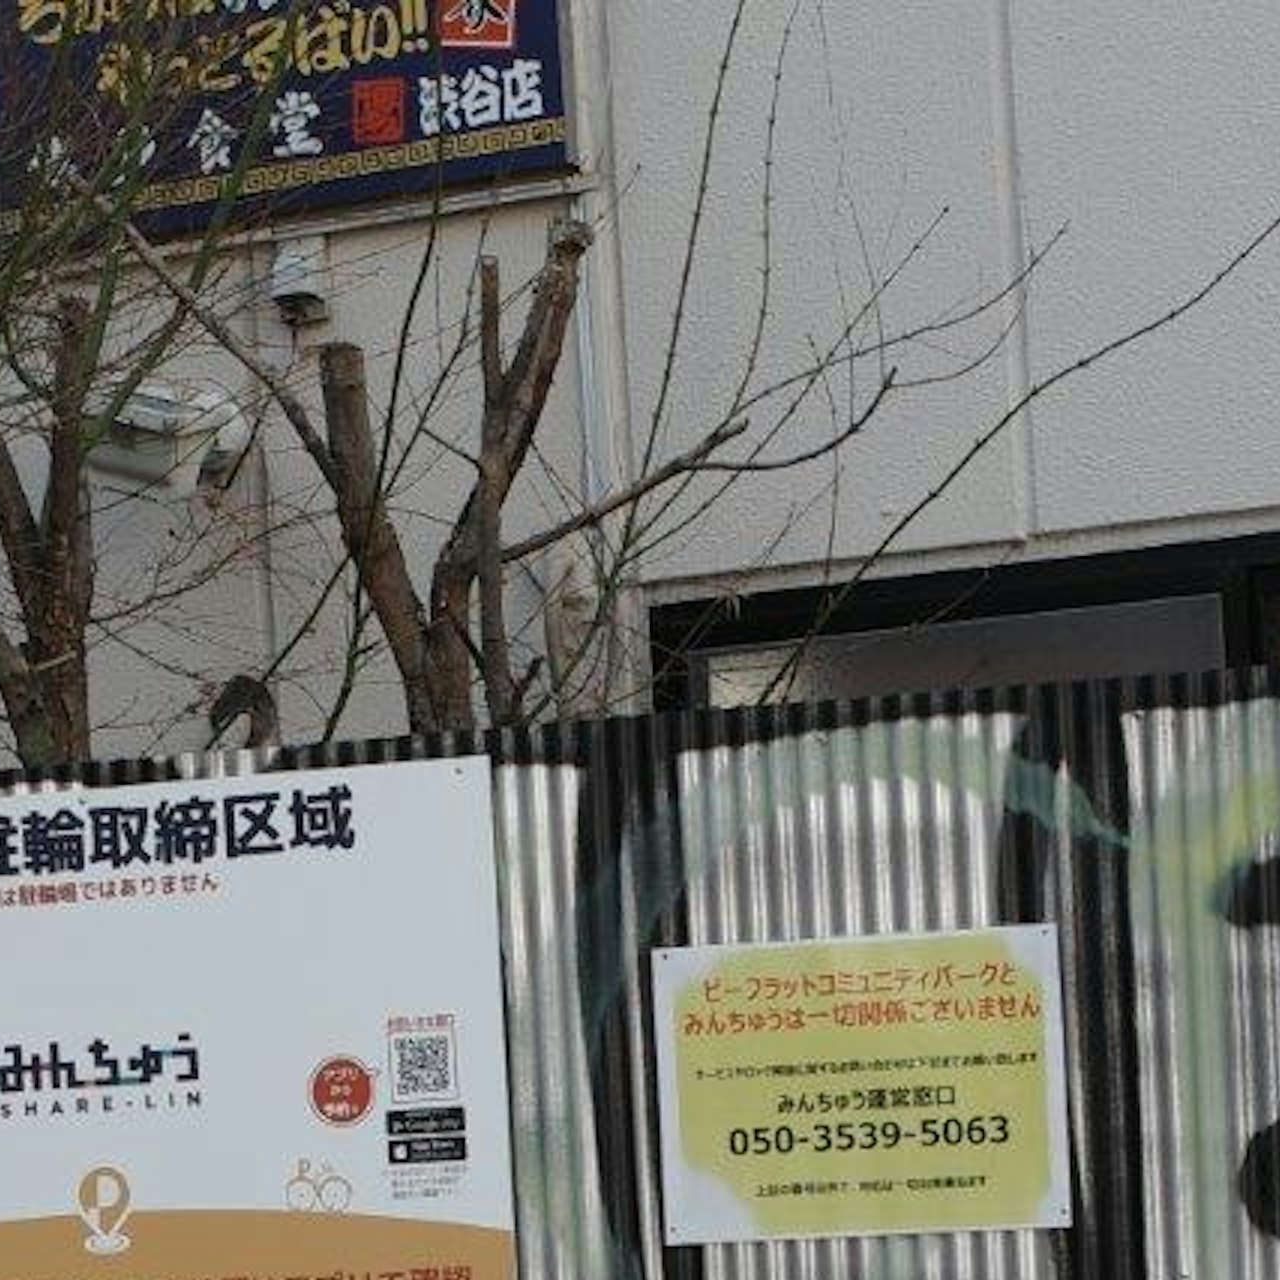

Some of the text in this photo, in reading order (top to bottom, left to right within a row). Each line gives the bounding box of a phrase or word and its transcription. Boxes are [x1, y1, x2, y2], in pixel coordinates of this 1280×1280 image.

[420, 59, 545, 137] 渋谷店
[0, 1091, 203, 1119] SHARE-LIN
[777, 1084, 956, 1114] みんちゅう運営窓口
[729, 1115, 1011, 1157] 050-3539-5063
